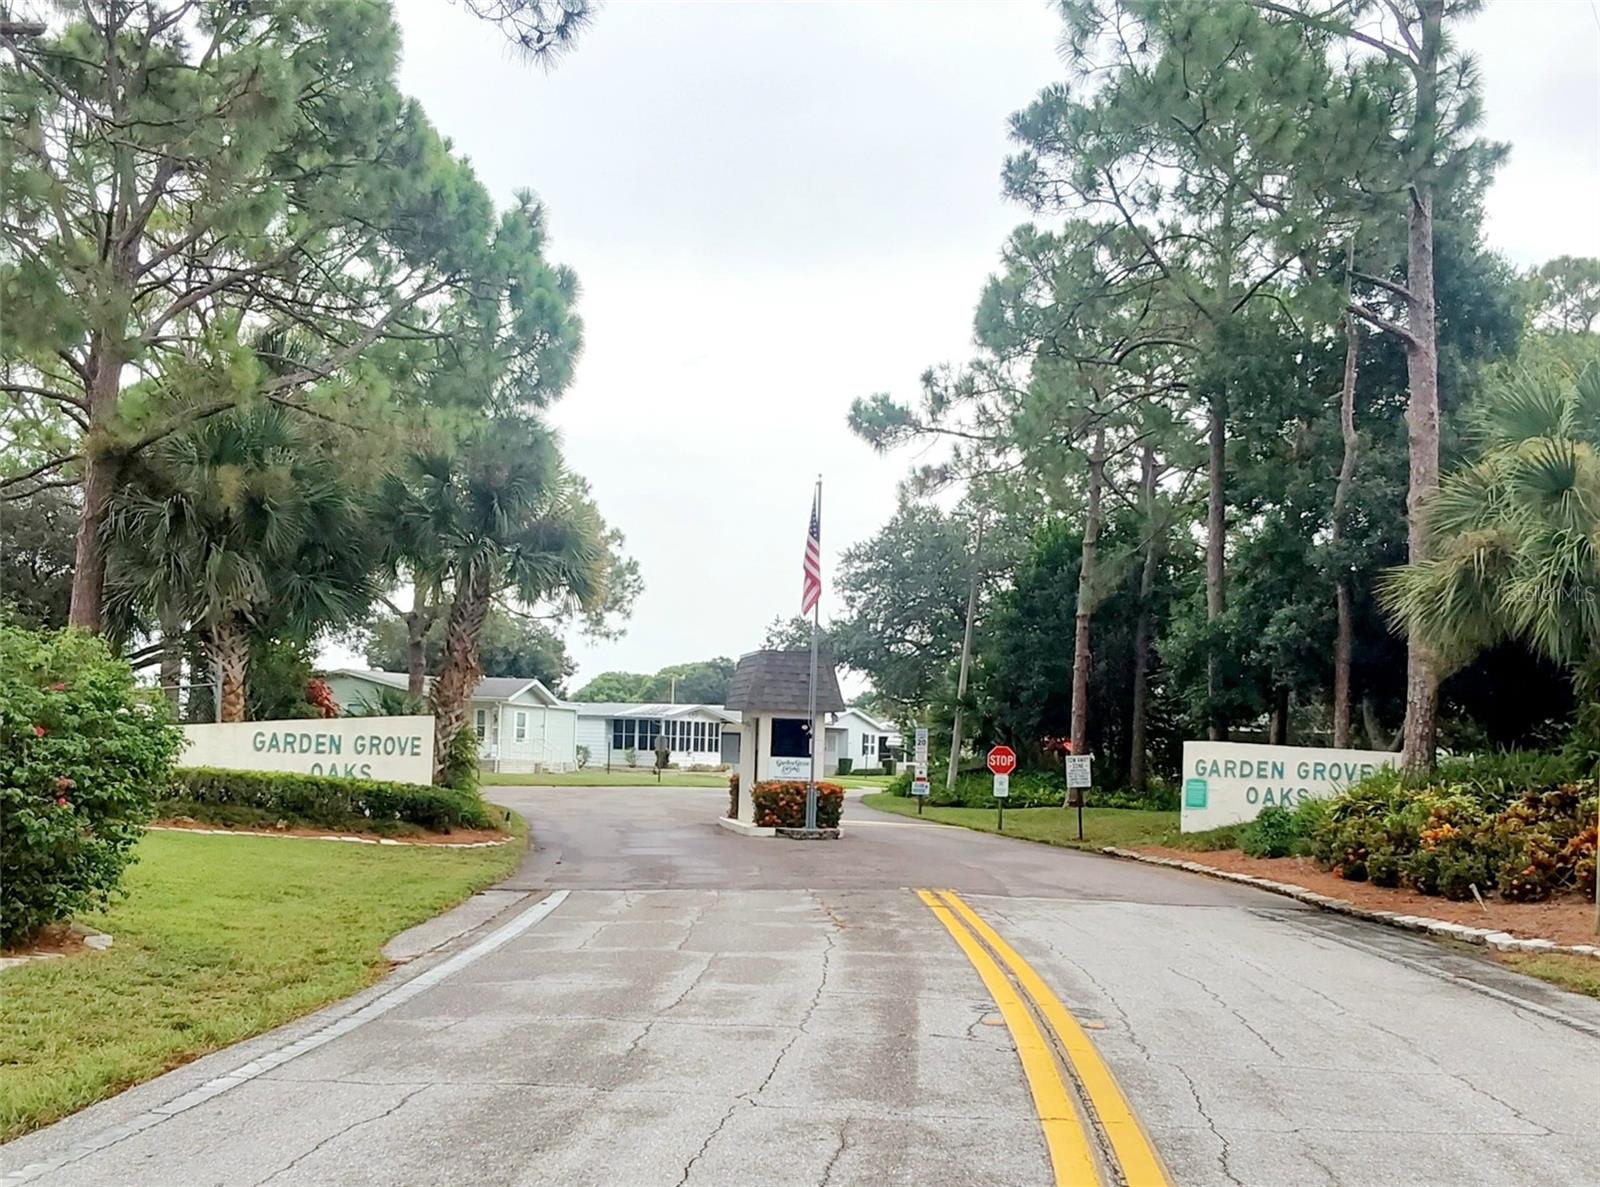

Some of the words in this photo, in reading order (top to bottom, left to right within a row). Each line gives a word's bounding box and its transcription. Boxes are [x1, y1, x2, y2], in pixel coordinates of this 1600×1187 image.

[253, 731, 342, 755] GARDEN
[354, 735, 421, 756] GROVE
[990, 755, 1014, 766] STOP
[1195, 759, 1284, 779] GARDEN
[1297, 761, 1374, 781] GROVE
